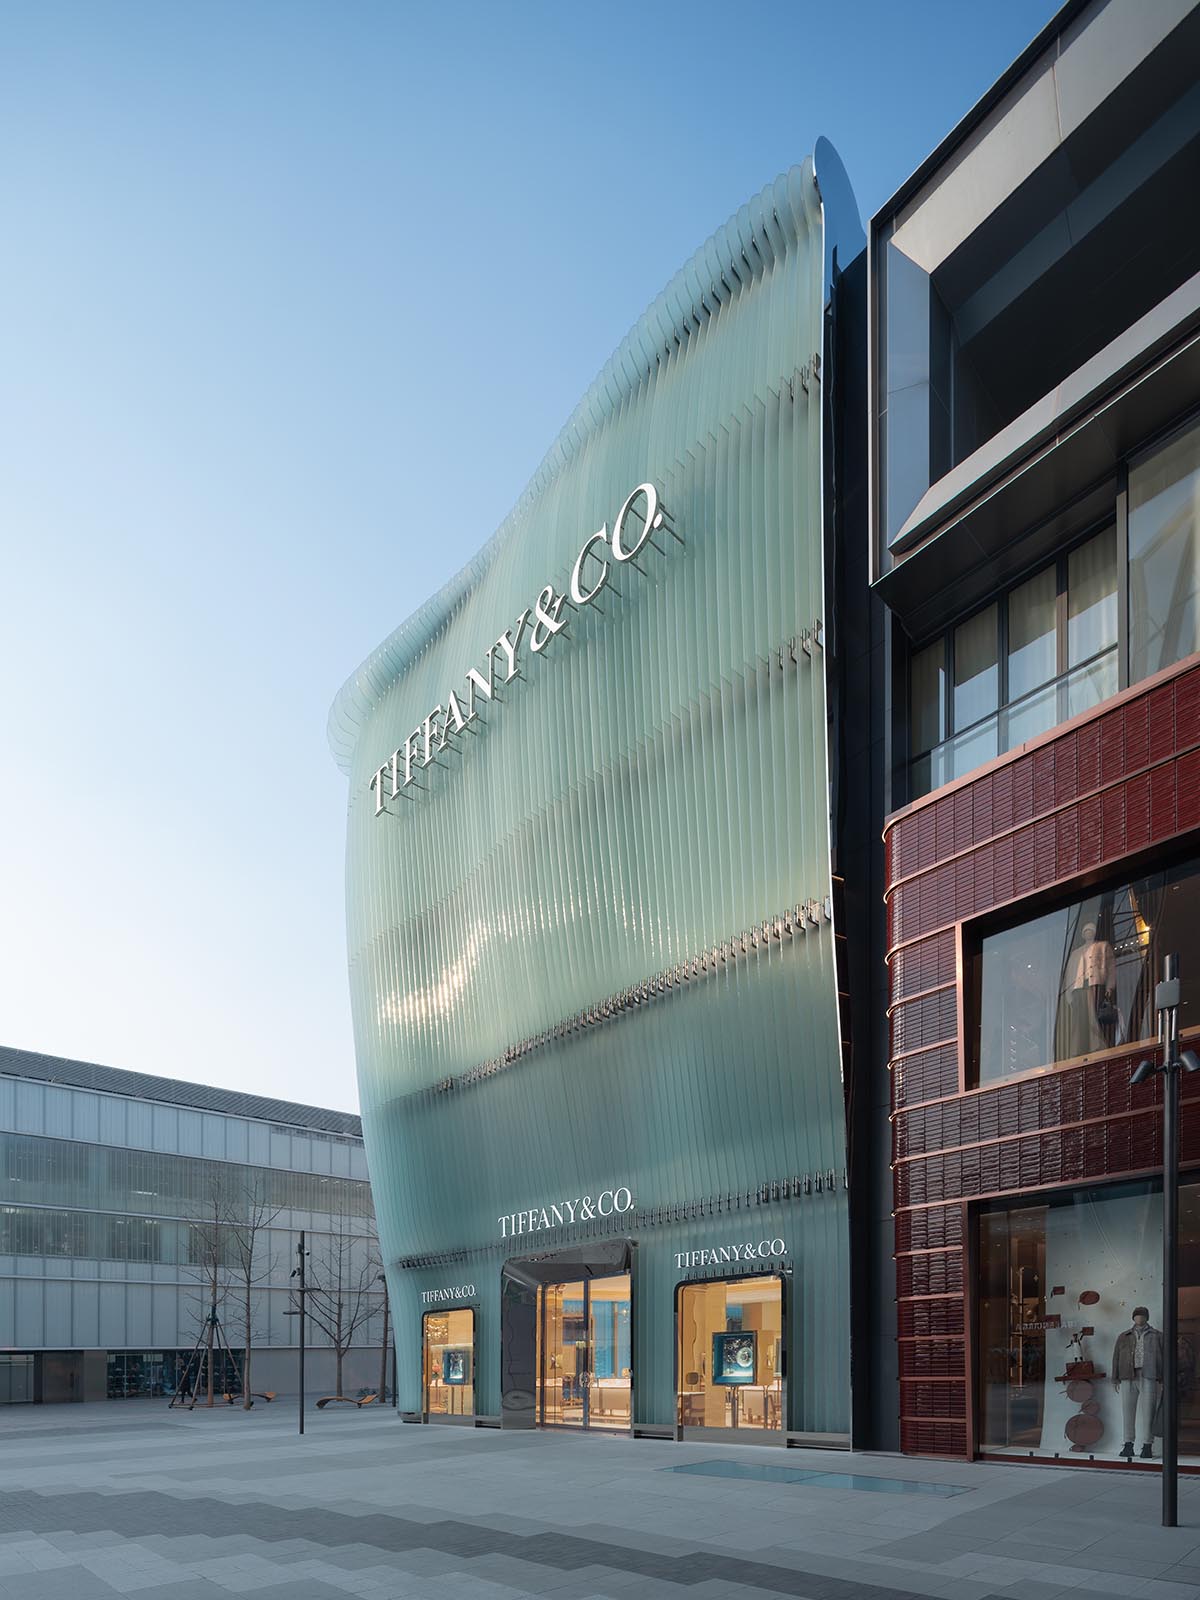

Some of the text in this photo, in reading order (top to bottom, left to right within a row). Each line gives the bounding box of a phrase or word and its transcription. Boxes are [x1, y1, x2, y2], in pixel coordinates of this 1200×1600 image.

[369, 482, 663, 817] TIFFANY&CO.
[497, 1187, 635, 1238] TIFFANY&CO.
[674, 1238, 788, 1269] TIFFANY&CO.
[421, 1284, 477, 1303] TIFFANY&CO.
